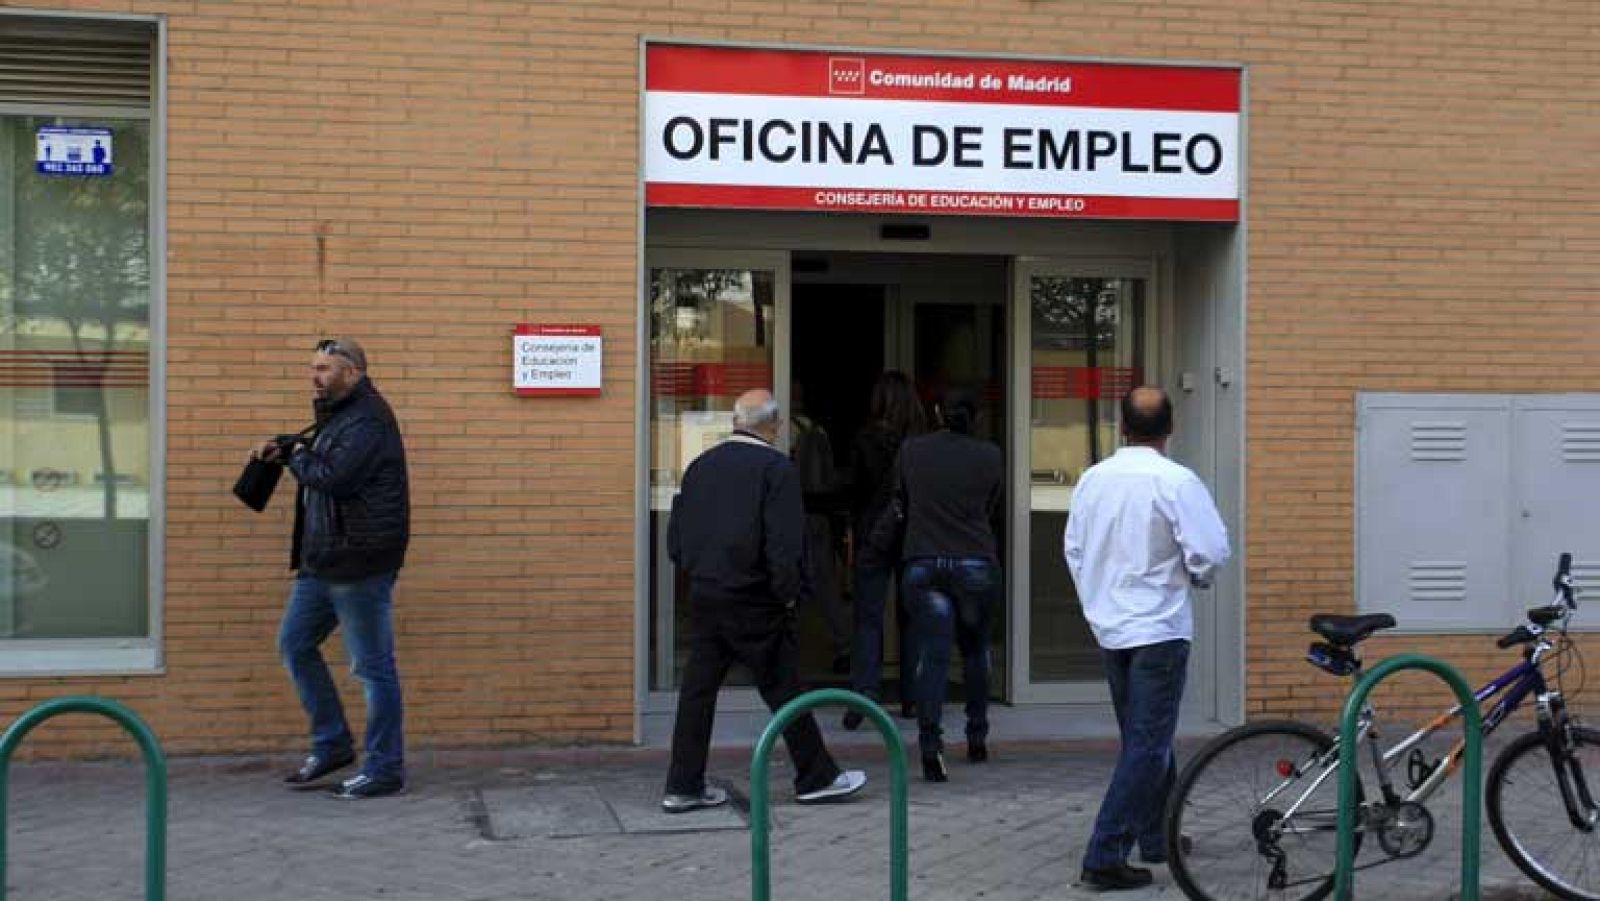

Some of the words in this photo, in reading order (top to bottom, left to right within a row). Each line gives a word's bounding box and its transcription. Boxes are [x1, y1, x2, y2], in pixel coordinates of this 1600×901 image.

[870, 70, 974, 88] Comunidad
[979, 75, 1002, 90] de
[1007, 76, 1071, 92] Madrid
[663, 116, 894, 166] OFICINA
[912, 124, 984, 167] DE
[1003, 127, 1222, 175] EMPLEO
[815, 190, 904, 206] CONSEJERÍA
[907, 193, 928, 207] DE
[1016, 198, 1025, 209] Y
[1028, 197, 1084, 211] EMPLEO
[581, 342, 595, 353] de
[531, 369, 572, 381] Empleo
